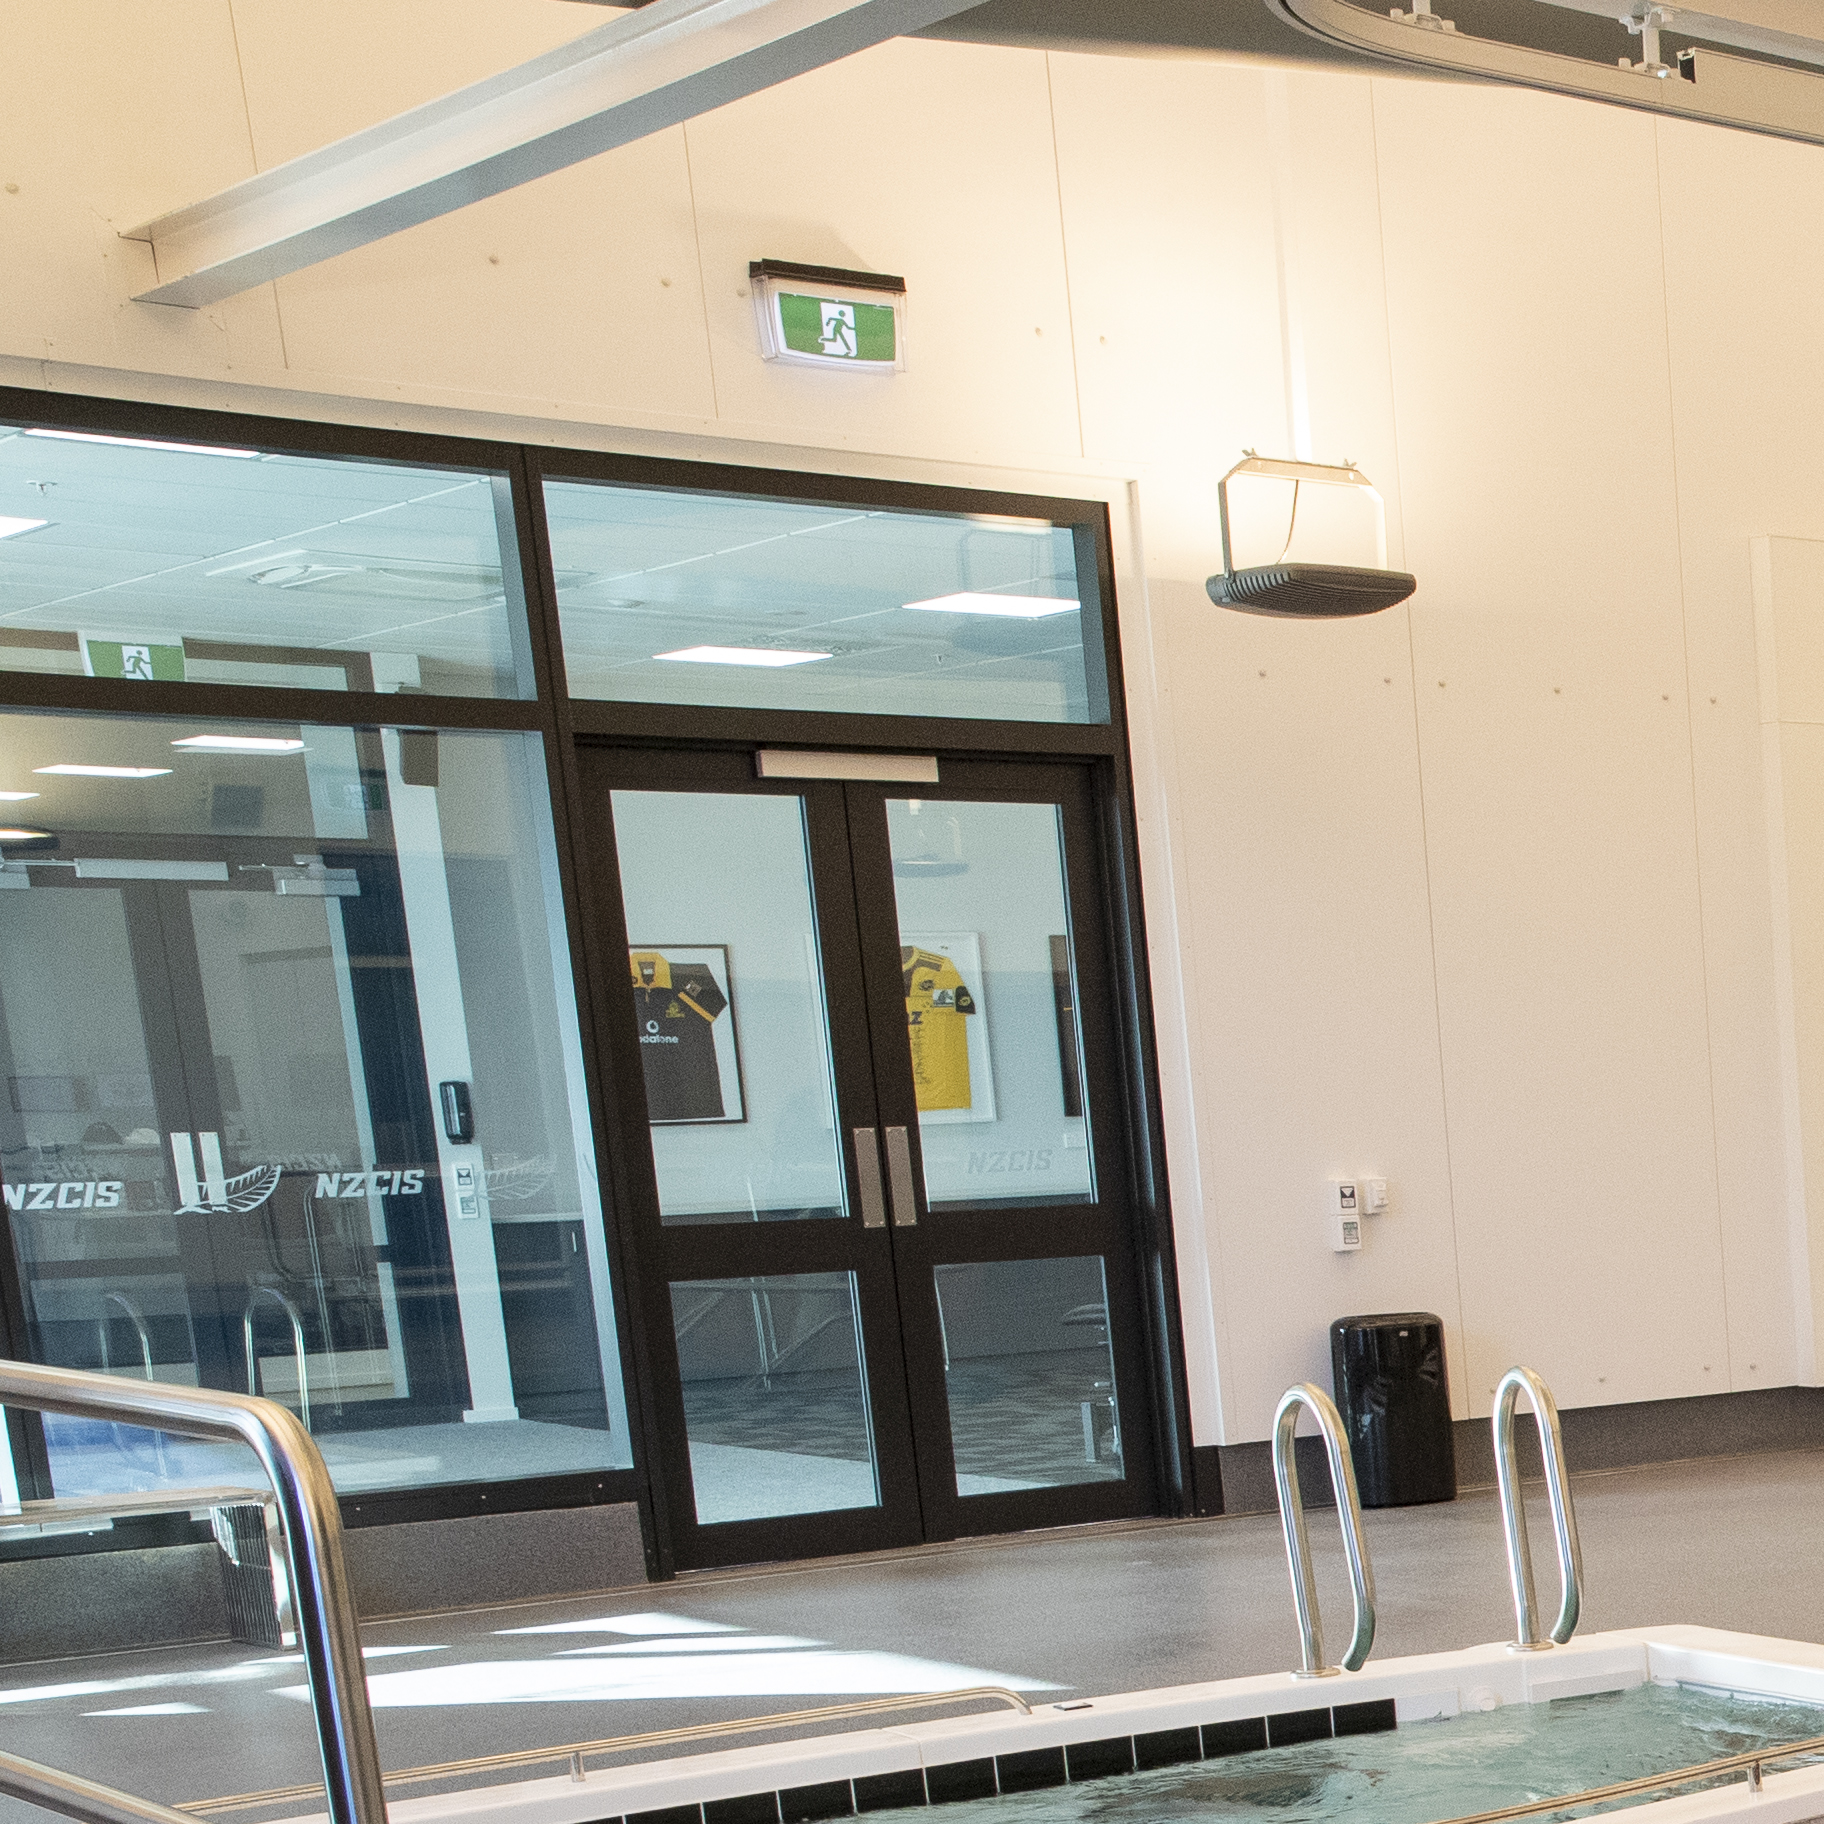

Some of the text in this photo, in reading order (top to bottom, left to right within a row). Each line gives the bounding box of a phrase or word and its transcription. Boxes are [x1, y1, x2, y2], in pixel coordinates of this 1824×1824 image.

[640, 1034, 679, 1044] odafone
[968, 1148, 1053, 1174] NZCIS
[2, 1181, 123, 1211] NZCIS
[315, 1169, 425, 1198] NZCIS
